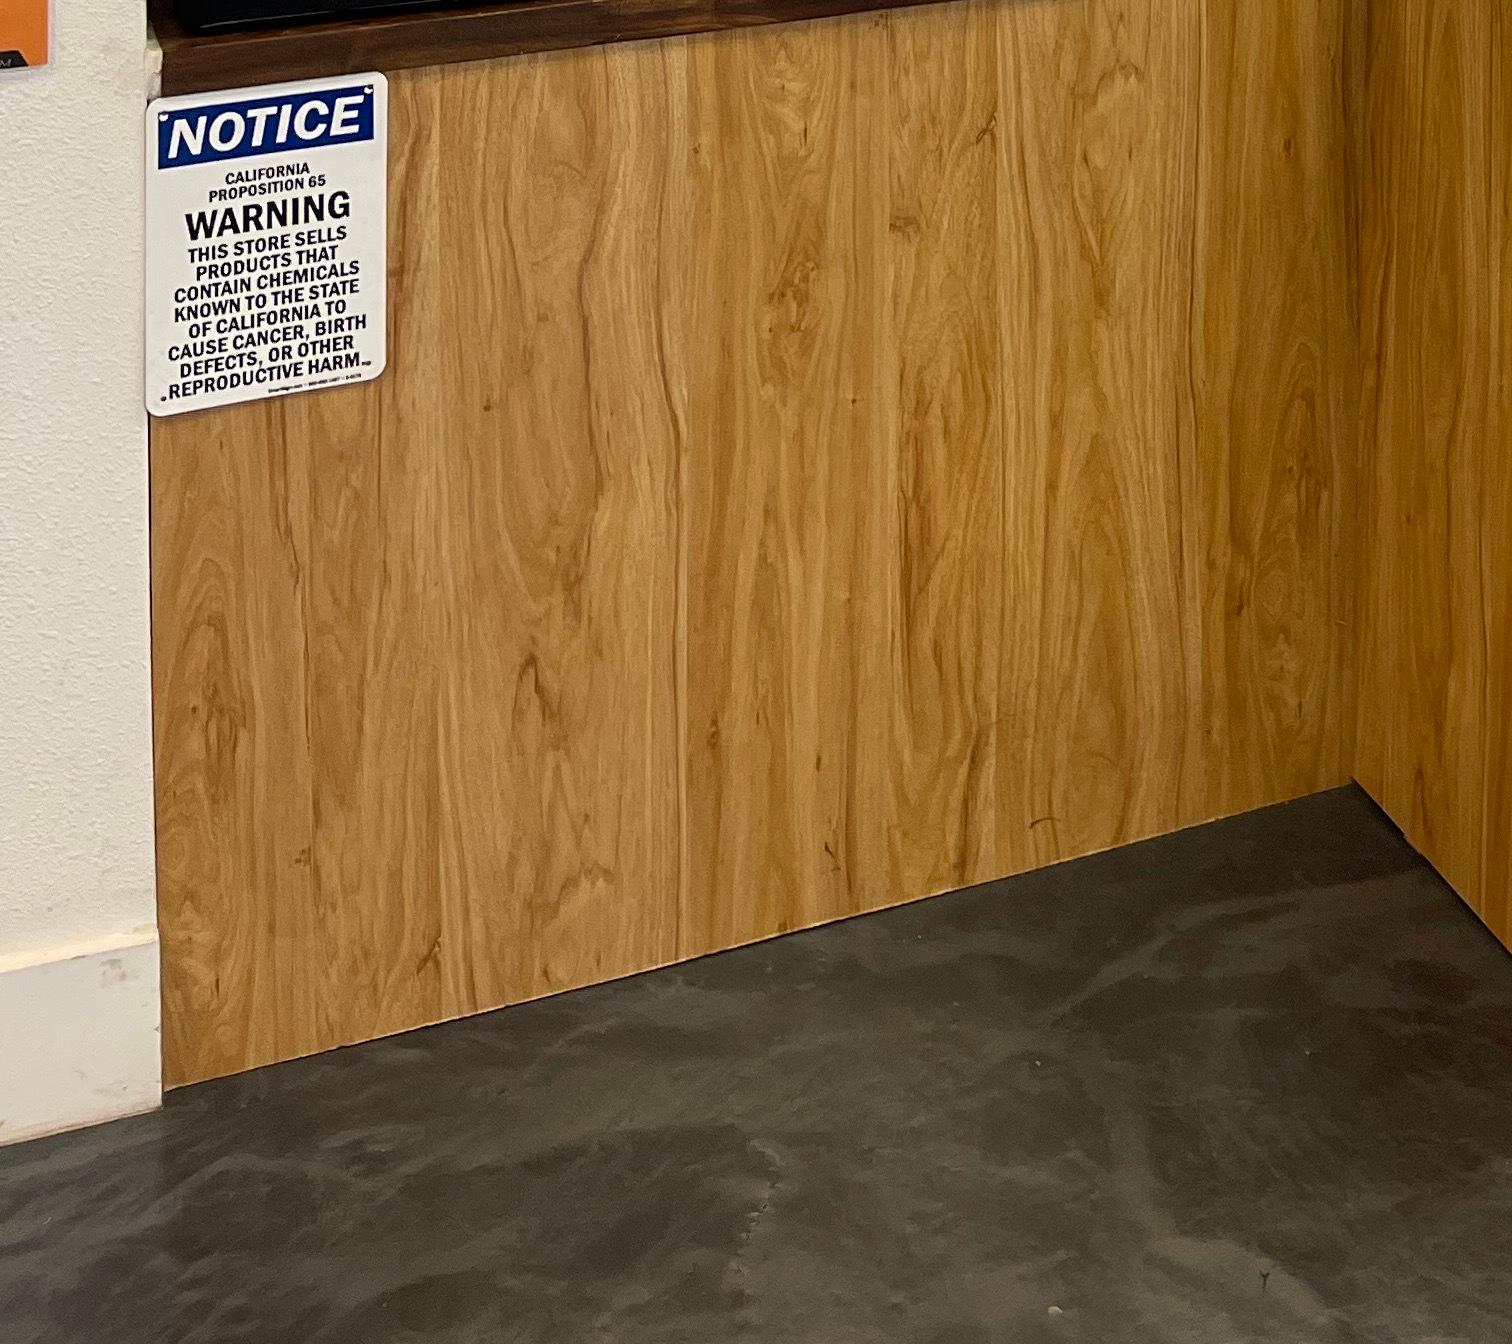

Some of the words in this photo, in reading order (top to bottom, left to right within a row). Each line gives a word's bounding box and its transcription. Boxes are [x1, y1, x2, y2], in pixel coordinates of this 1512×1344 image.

[168, 95, 364, 159] NOTICE
[209, 178, 304, 202] PROPOSITION
[308, 174, 326, 188] 65
[225, 162, 310, 185] CALIFORNIA
[185, 190, 350, 241] WARNING
[188, 244, 231, 263] THIS
[234, 234, 290, 257] STORE
[295, 225, 347, 247] SELLS
[196, 255, 291, 281] PRODUCTS
[296, 245, 338, 262] THAT
[174, 280, 251, 303] CONTAIN
[256, 260, 359, 290] CHEMICALS
[174, 300, 240, 323] KNOWN
[245, 295, 266, 310] TO
[271, 288, 304, 305] THE
[309, 279, 360, 300] STATE
[168, 340, 228, 362] CAUSE
[232, 325, 309, 351] CANCER,
[315, 314, 367, 338] BIRTH
[188, 322, 211, 339] OF
[216, 306, 320, 334] CALIFORNIA
[325, 300, 346, 315] TO
[169, 365, 304, 400] REPRODUCTIVE
[308, 352, 363, 375] HARM.
[180, 354, 262, 379] DEFECTS,
[268, 345, 293, 362] OR
[300, 335, 354, 357] OTHER
